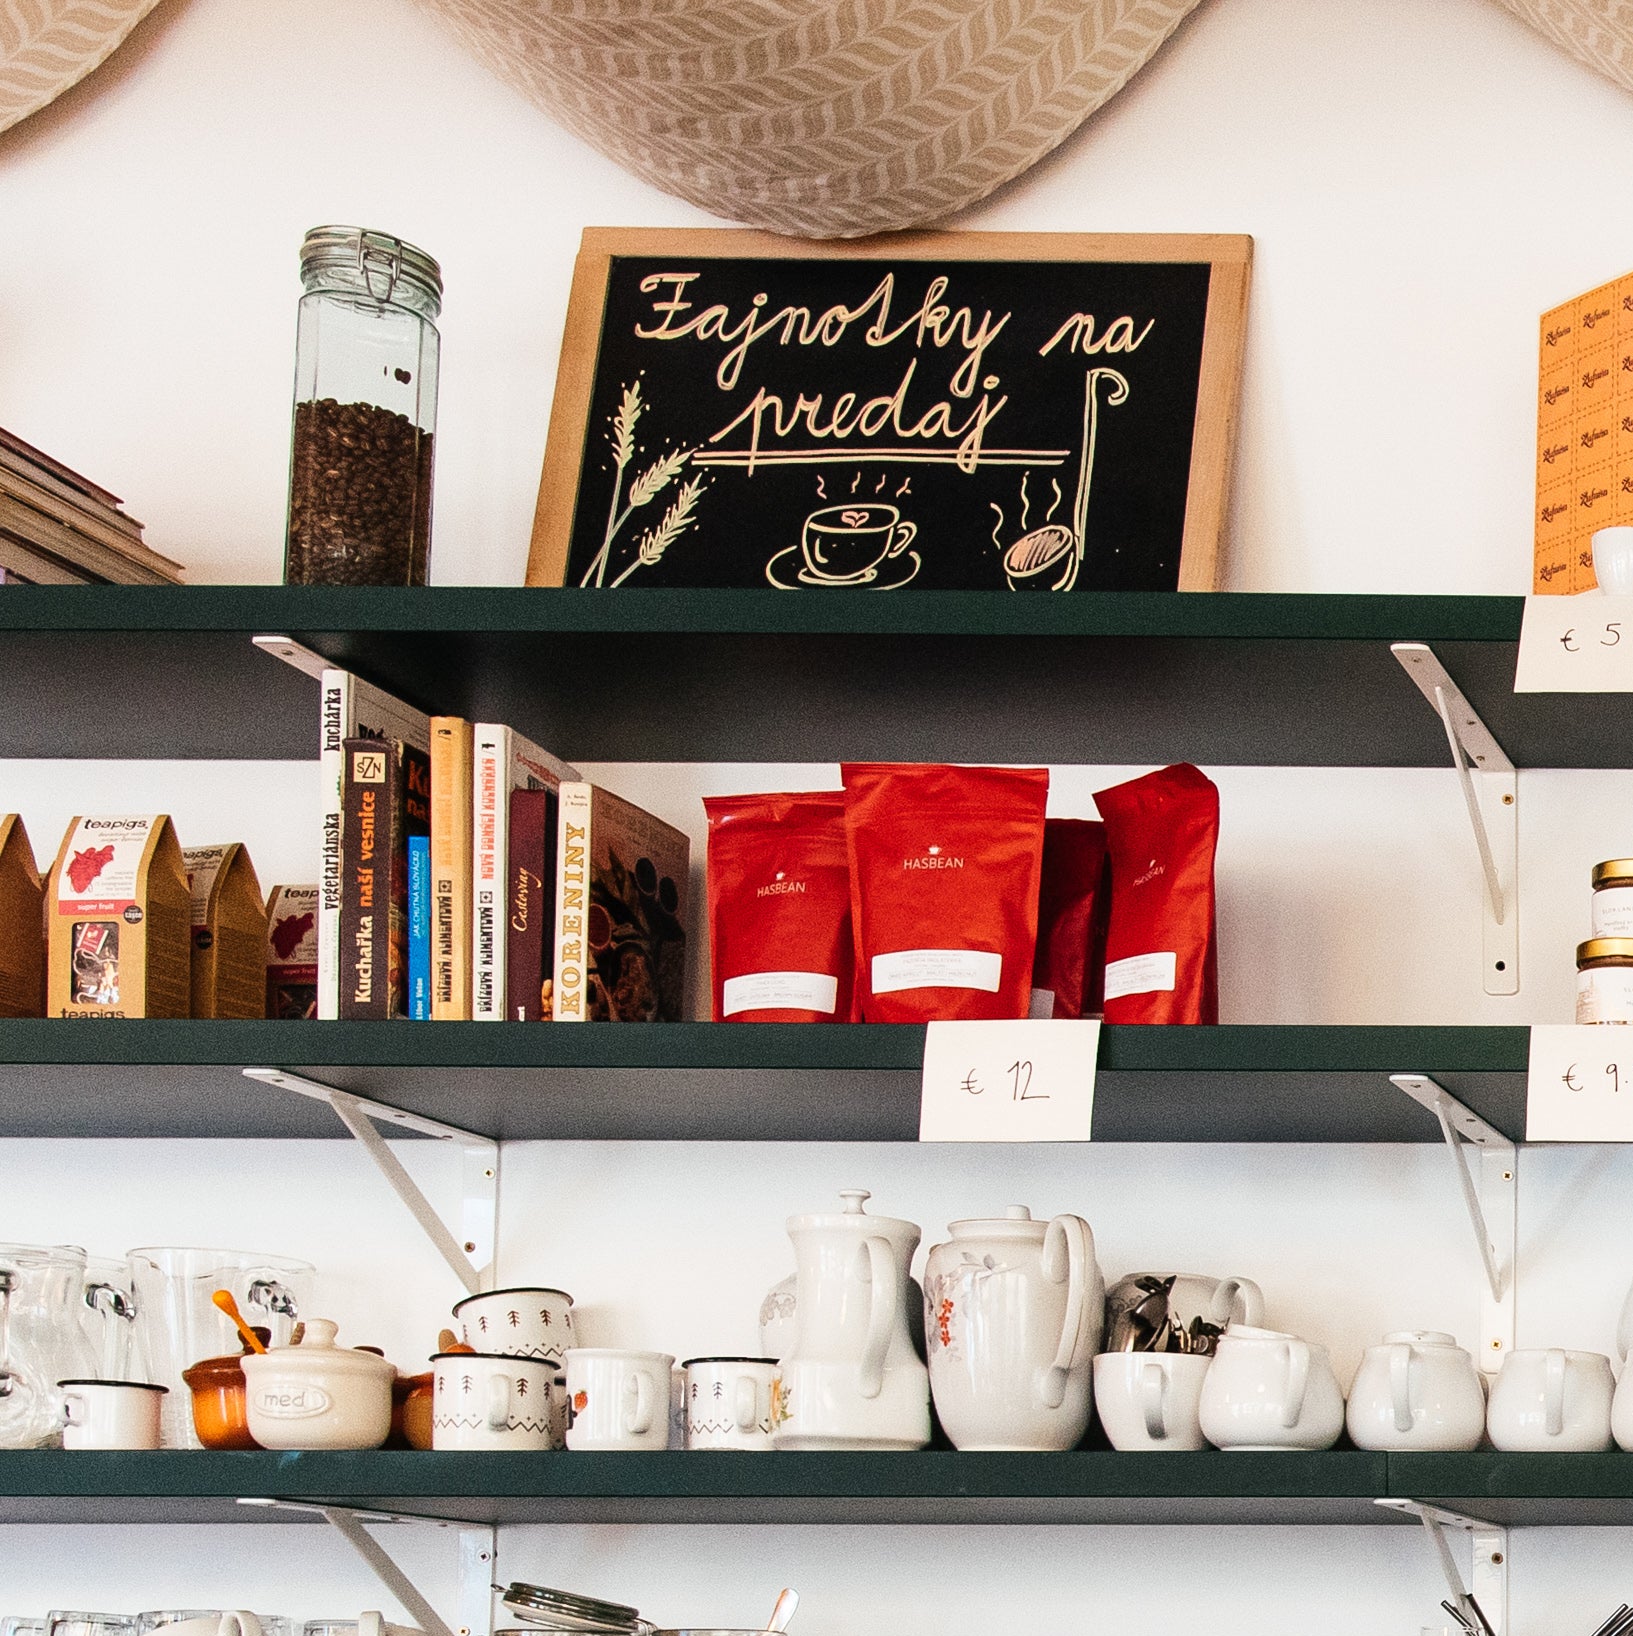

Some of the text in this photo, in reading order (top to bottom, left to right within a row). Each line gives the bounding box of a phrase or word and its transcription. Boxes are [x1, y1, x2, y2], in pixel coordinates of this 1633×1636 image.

[1039, 312, 1155, 358] na
[709, 358, 1009, 475] predaj
[1560, 623, 1621, 651] € 5
[324, 687, 341, 752] kuchárka
[324, 813, 341, 911] vegetariánska
[903, 856, 964, 870] HASBEAN
[98, 902, 115, 910] fruit
[355, 791, 376, 1004] Kuchařka naší vesnice
[756, 881, 807, 898] HASBEAN
[561, 822, 585, 1015] KORENINY
[960, 1060, 1050, 1101] € 12
[1561, 1063, 1584, 1092] €
[263, 1391, 306, 1408] med
